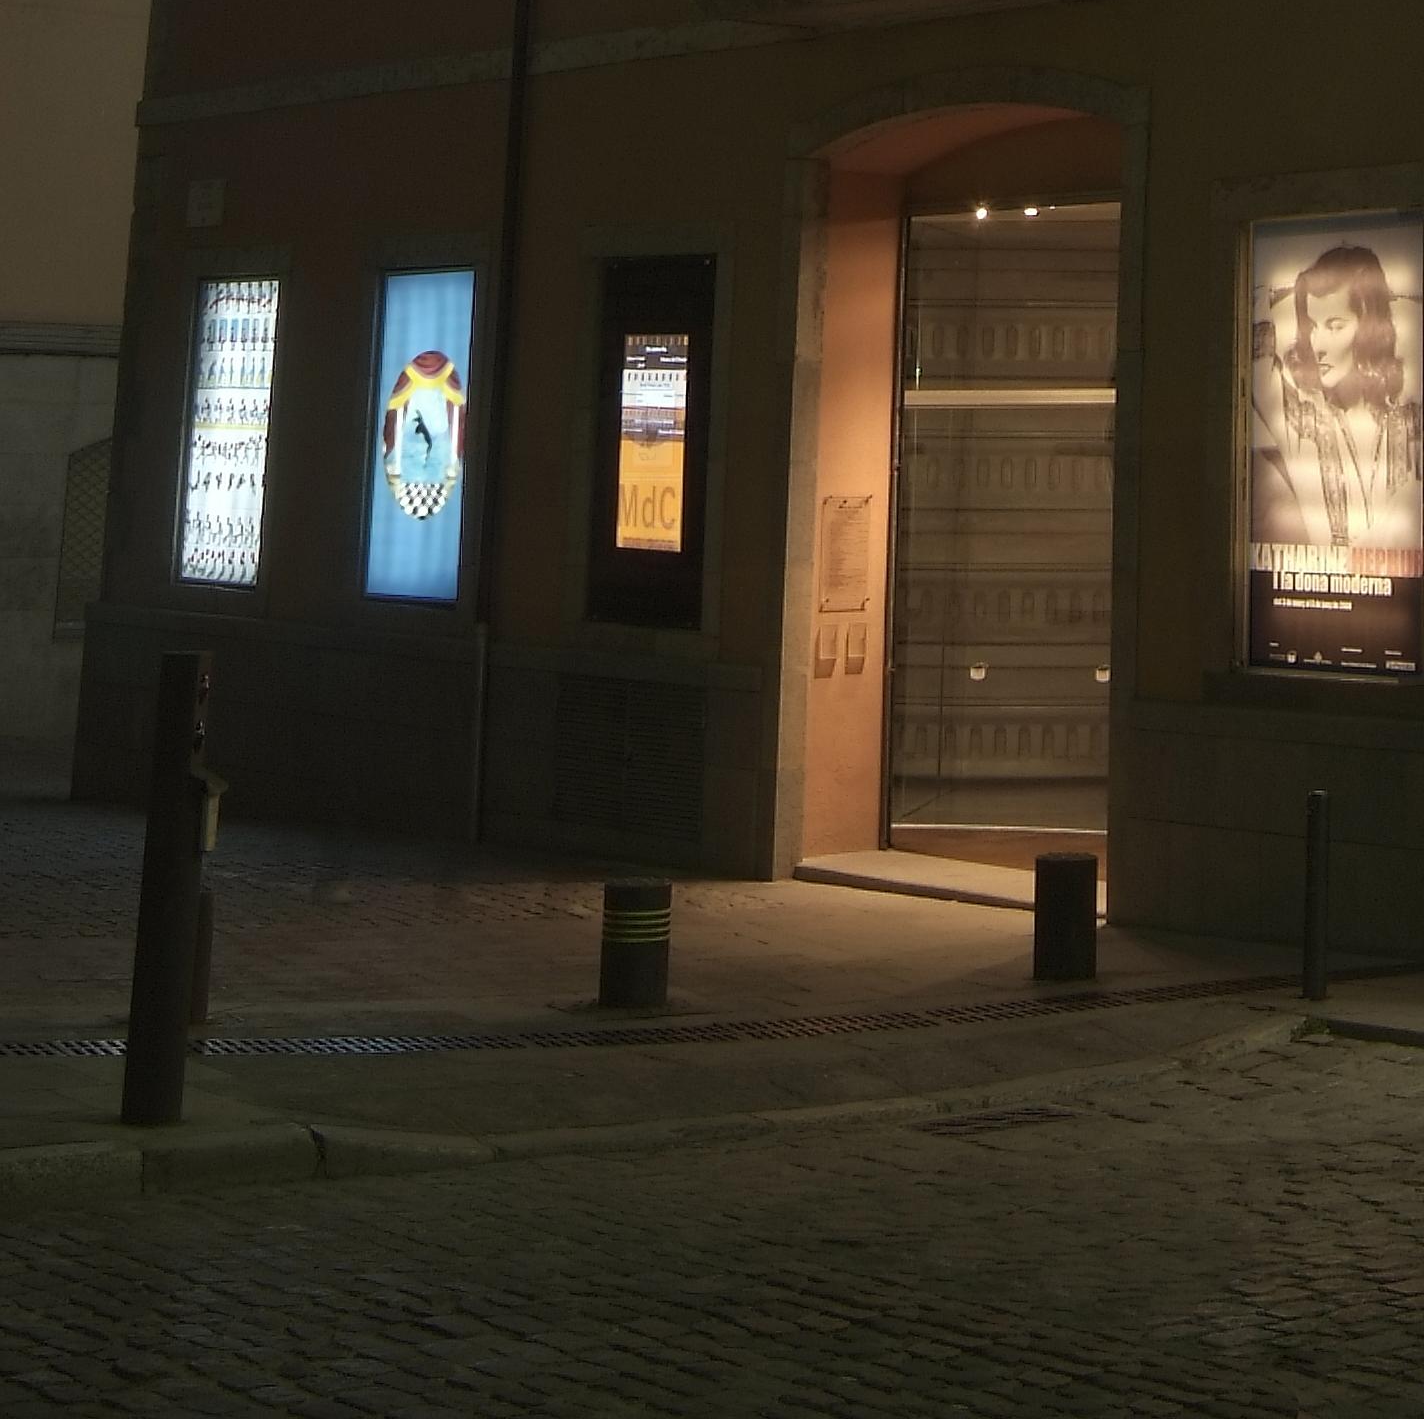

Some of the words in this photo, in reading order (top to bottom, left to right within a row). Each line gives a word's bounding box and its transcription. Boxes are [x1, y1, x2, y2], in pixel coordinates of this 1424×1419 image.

[619, 483, 677, 530] MdC
[1280, 570, 1294, 591] la
[1294, 572, 1329, 594] dona
[1330, 573, 1393, 597] moderna
